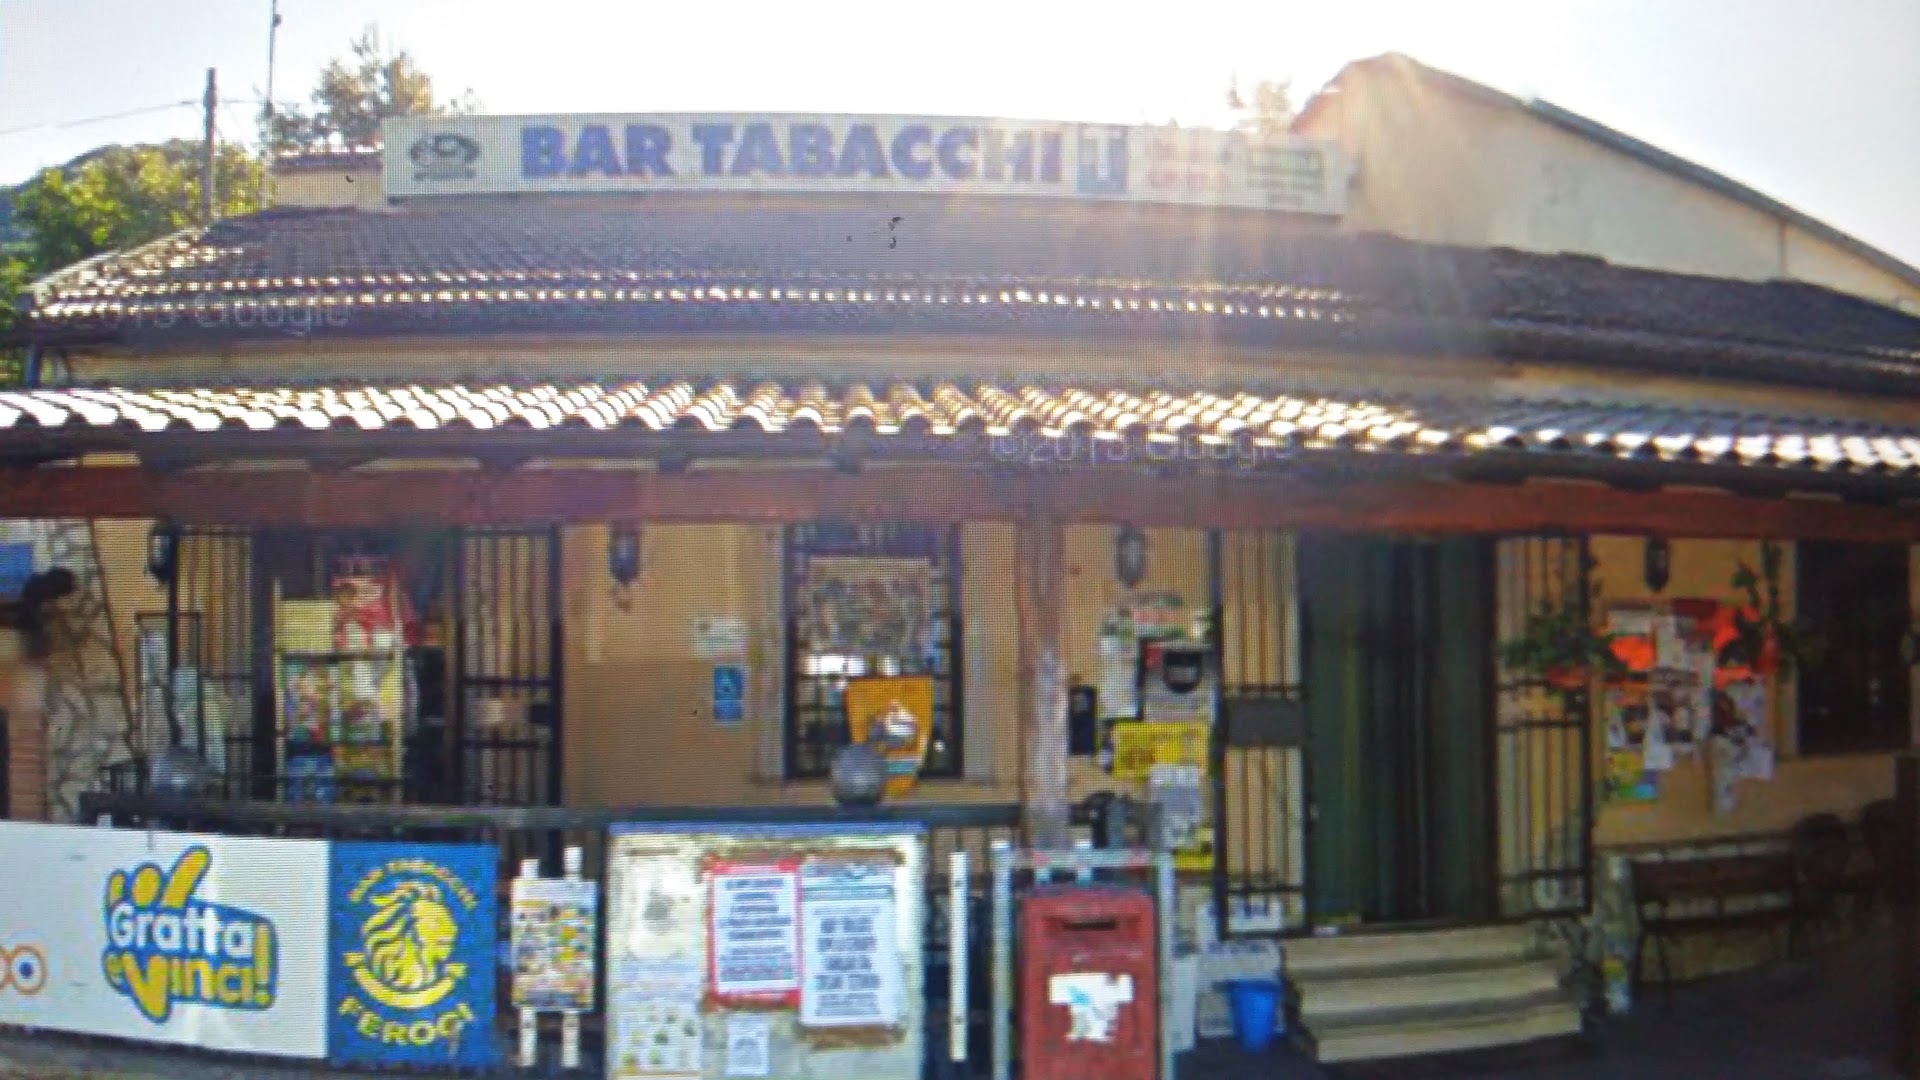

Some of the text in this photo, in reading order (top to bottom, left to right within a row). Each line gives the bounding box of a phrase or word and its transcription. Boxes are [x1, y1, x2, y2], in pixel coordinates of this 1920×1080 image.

[521, 123, 678, 179] BAR
[691, 121, 1063, 182] TABACCHI
[110, 902, 254, 958] Gratta
